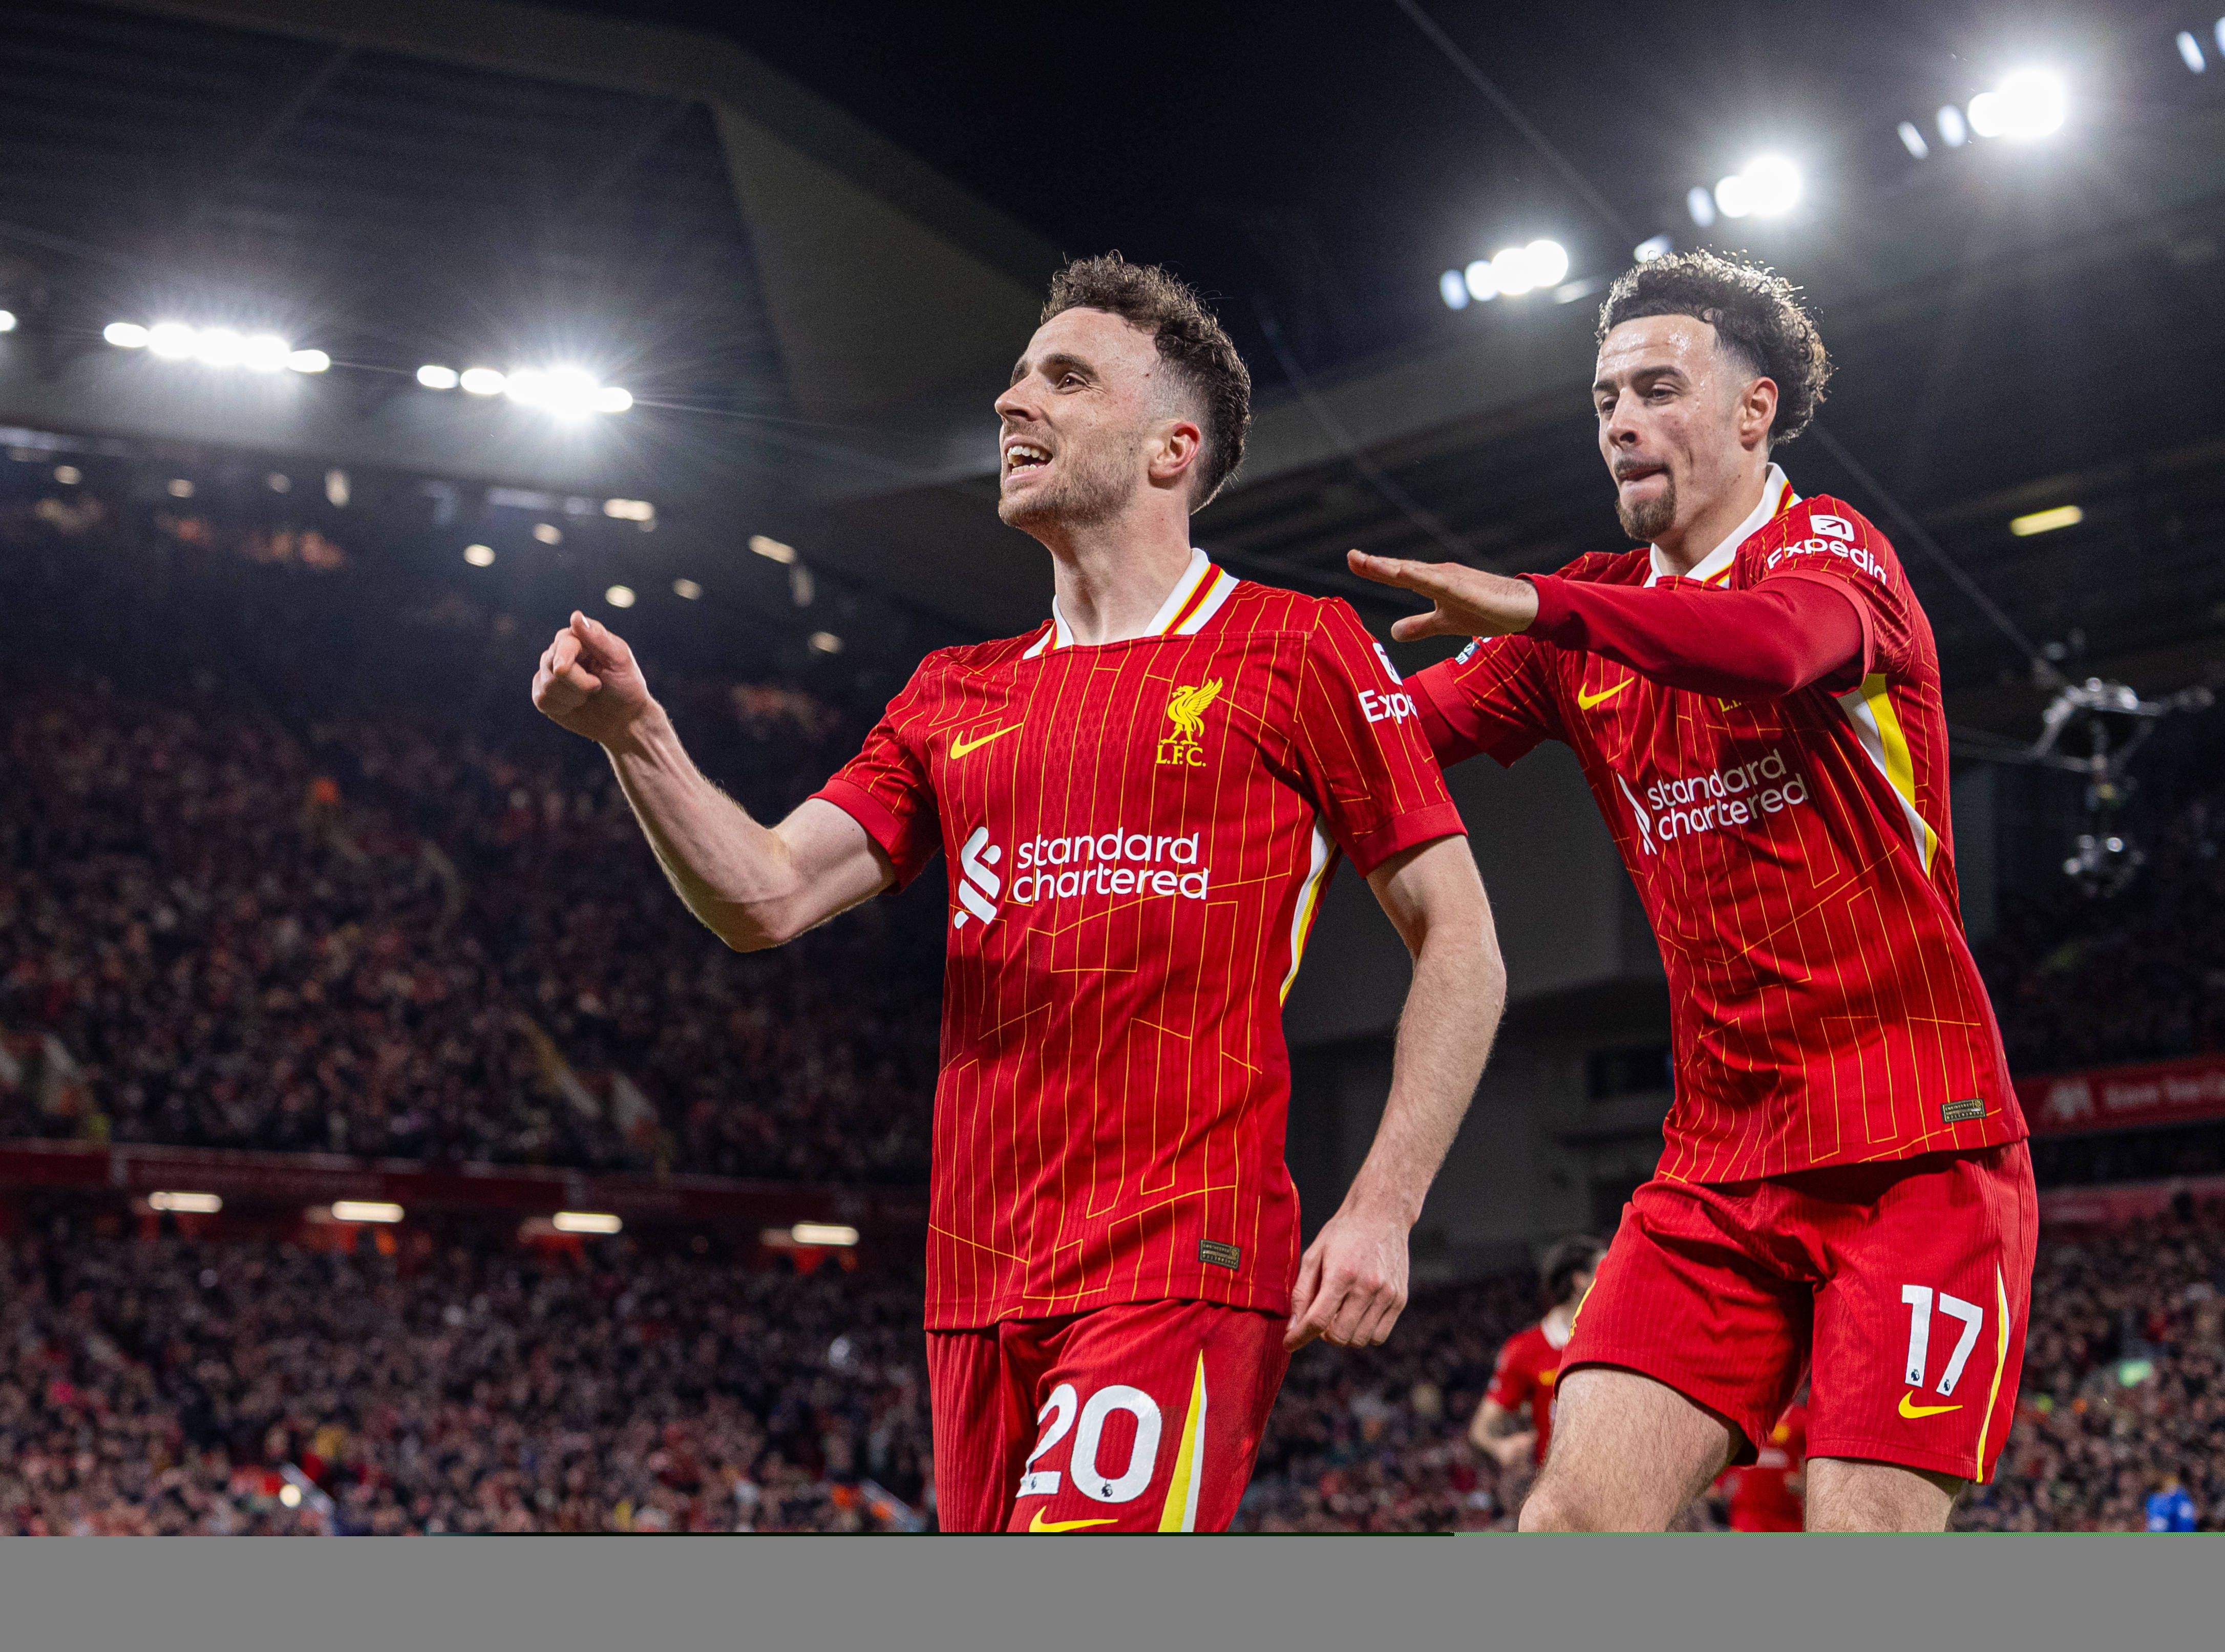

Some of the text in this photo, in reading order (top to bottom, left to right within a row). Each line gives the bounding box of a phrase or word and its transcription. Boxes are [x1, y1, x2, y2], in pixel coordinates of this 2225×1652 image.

[1155, 745, 1206, 767] L.F.C.
[1648, 748, 1787, 811] standard
[1658, 773, 1809, 841] chartered
[1017, 827, 1199, 870] standard
[1013, 862, 1209, 903] chartered
[1901, 1284, 1983, 1397] 17
[1015, 1383, 1163, 1503] 20
